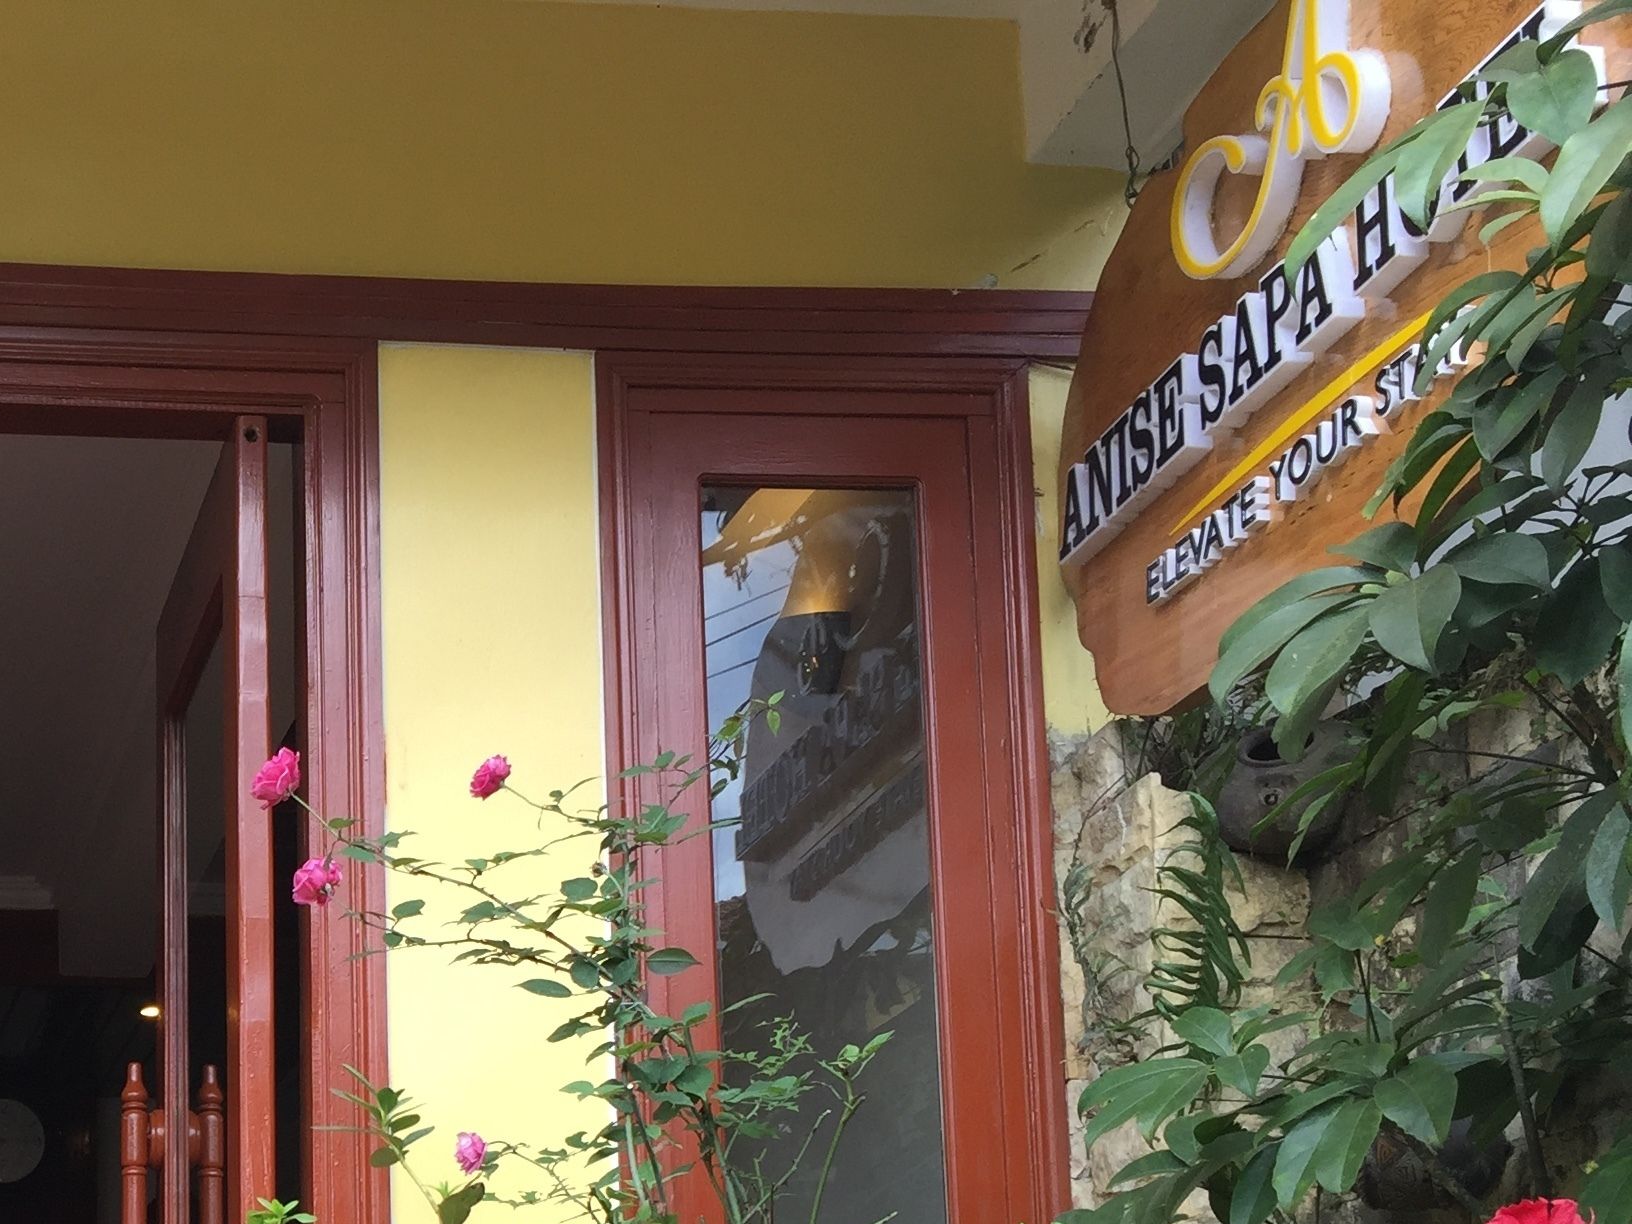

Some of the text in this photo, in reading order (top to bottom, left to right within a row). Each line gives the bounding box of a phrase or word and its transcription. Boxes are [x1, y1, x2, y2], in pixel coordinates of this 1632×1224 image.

[1059, 4, 1548, 558] ANISE SAPA HTE
[1146, 318, 1484, 602] ELEVATE YOUR ST
